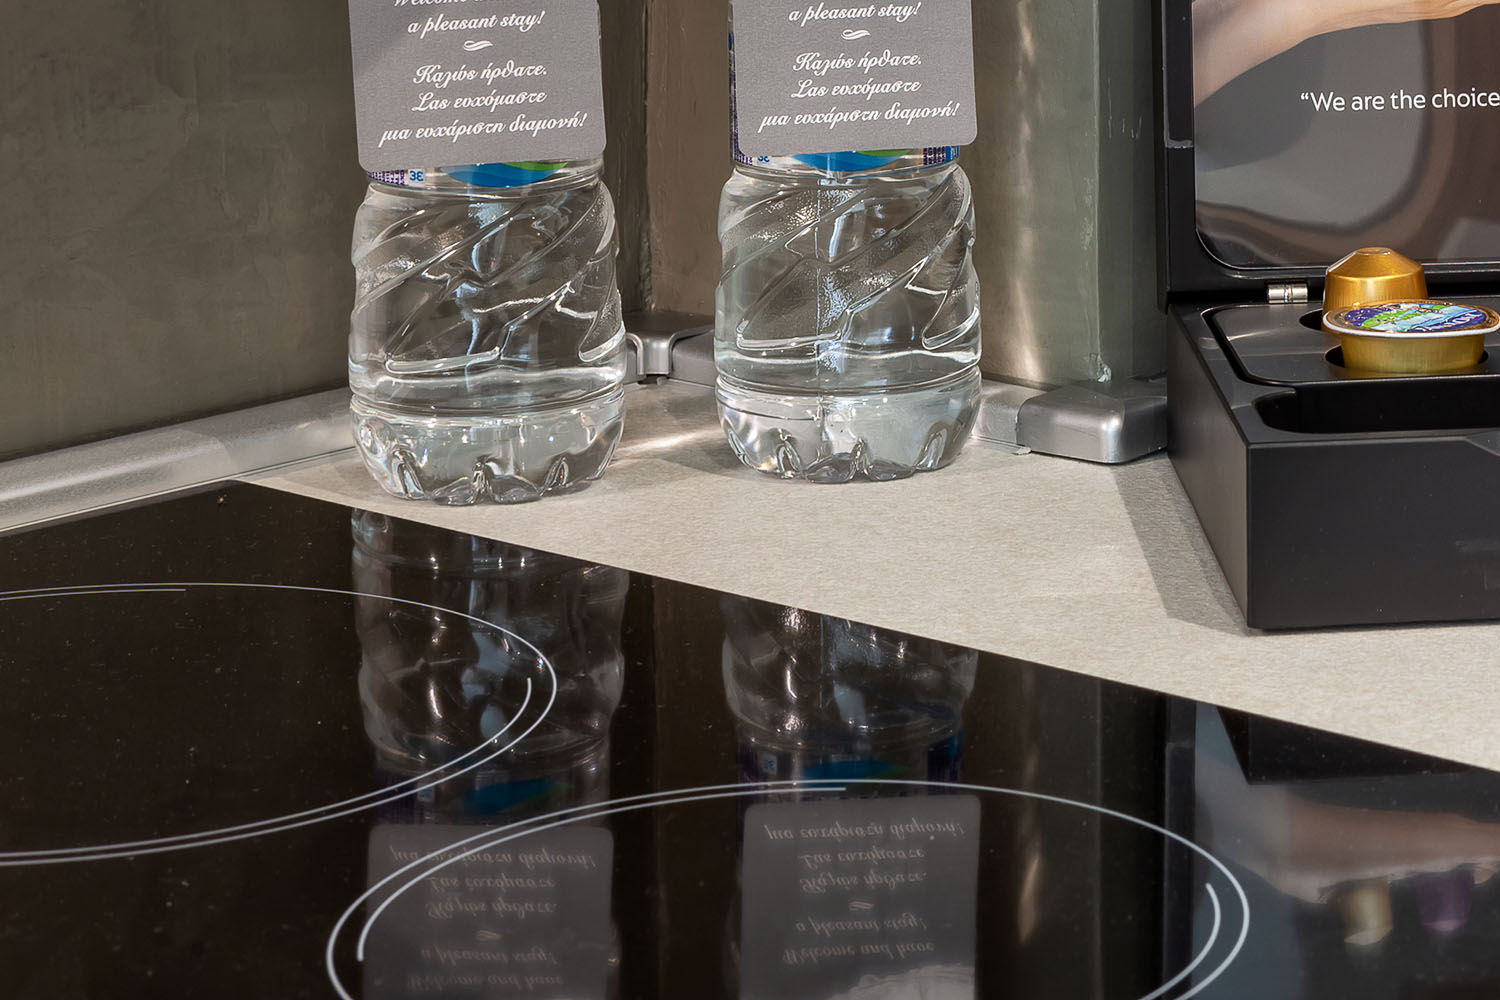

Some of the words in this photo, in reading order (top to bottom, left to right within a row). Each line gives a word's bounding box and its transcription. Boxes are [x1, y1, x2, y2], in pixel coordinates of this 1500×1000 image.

[407, 21, 421, 34] a
[420, 13, 498, 39] pleasant
[500, 10, 546, 32] stay!
[788, 11, 802, 22] a
[801, 2, 875, 27] pleasant
[878, 2, 922, 23] stay!
[1351, 95, 1385, 111] are
[1390, 89, 1426, 110] the
